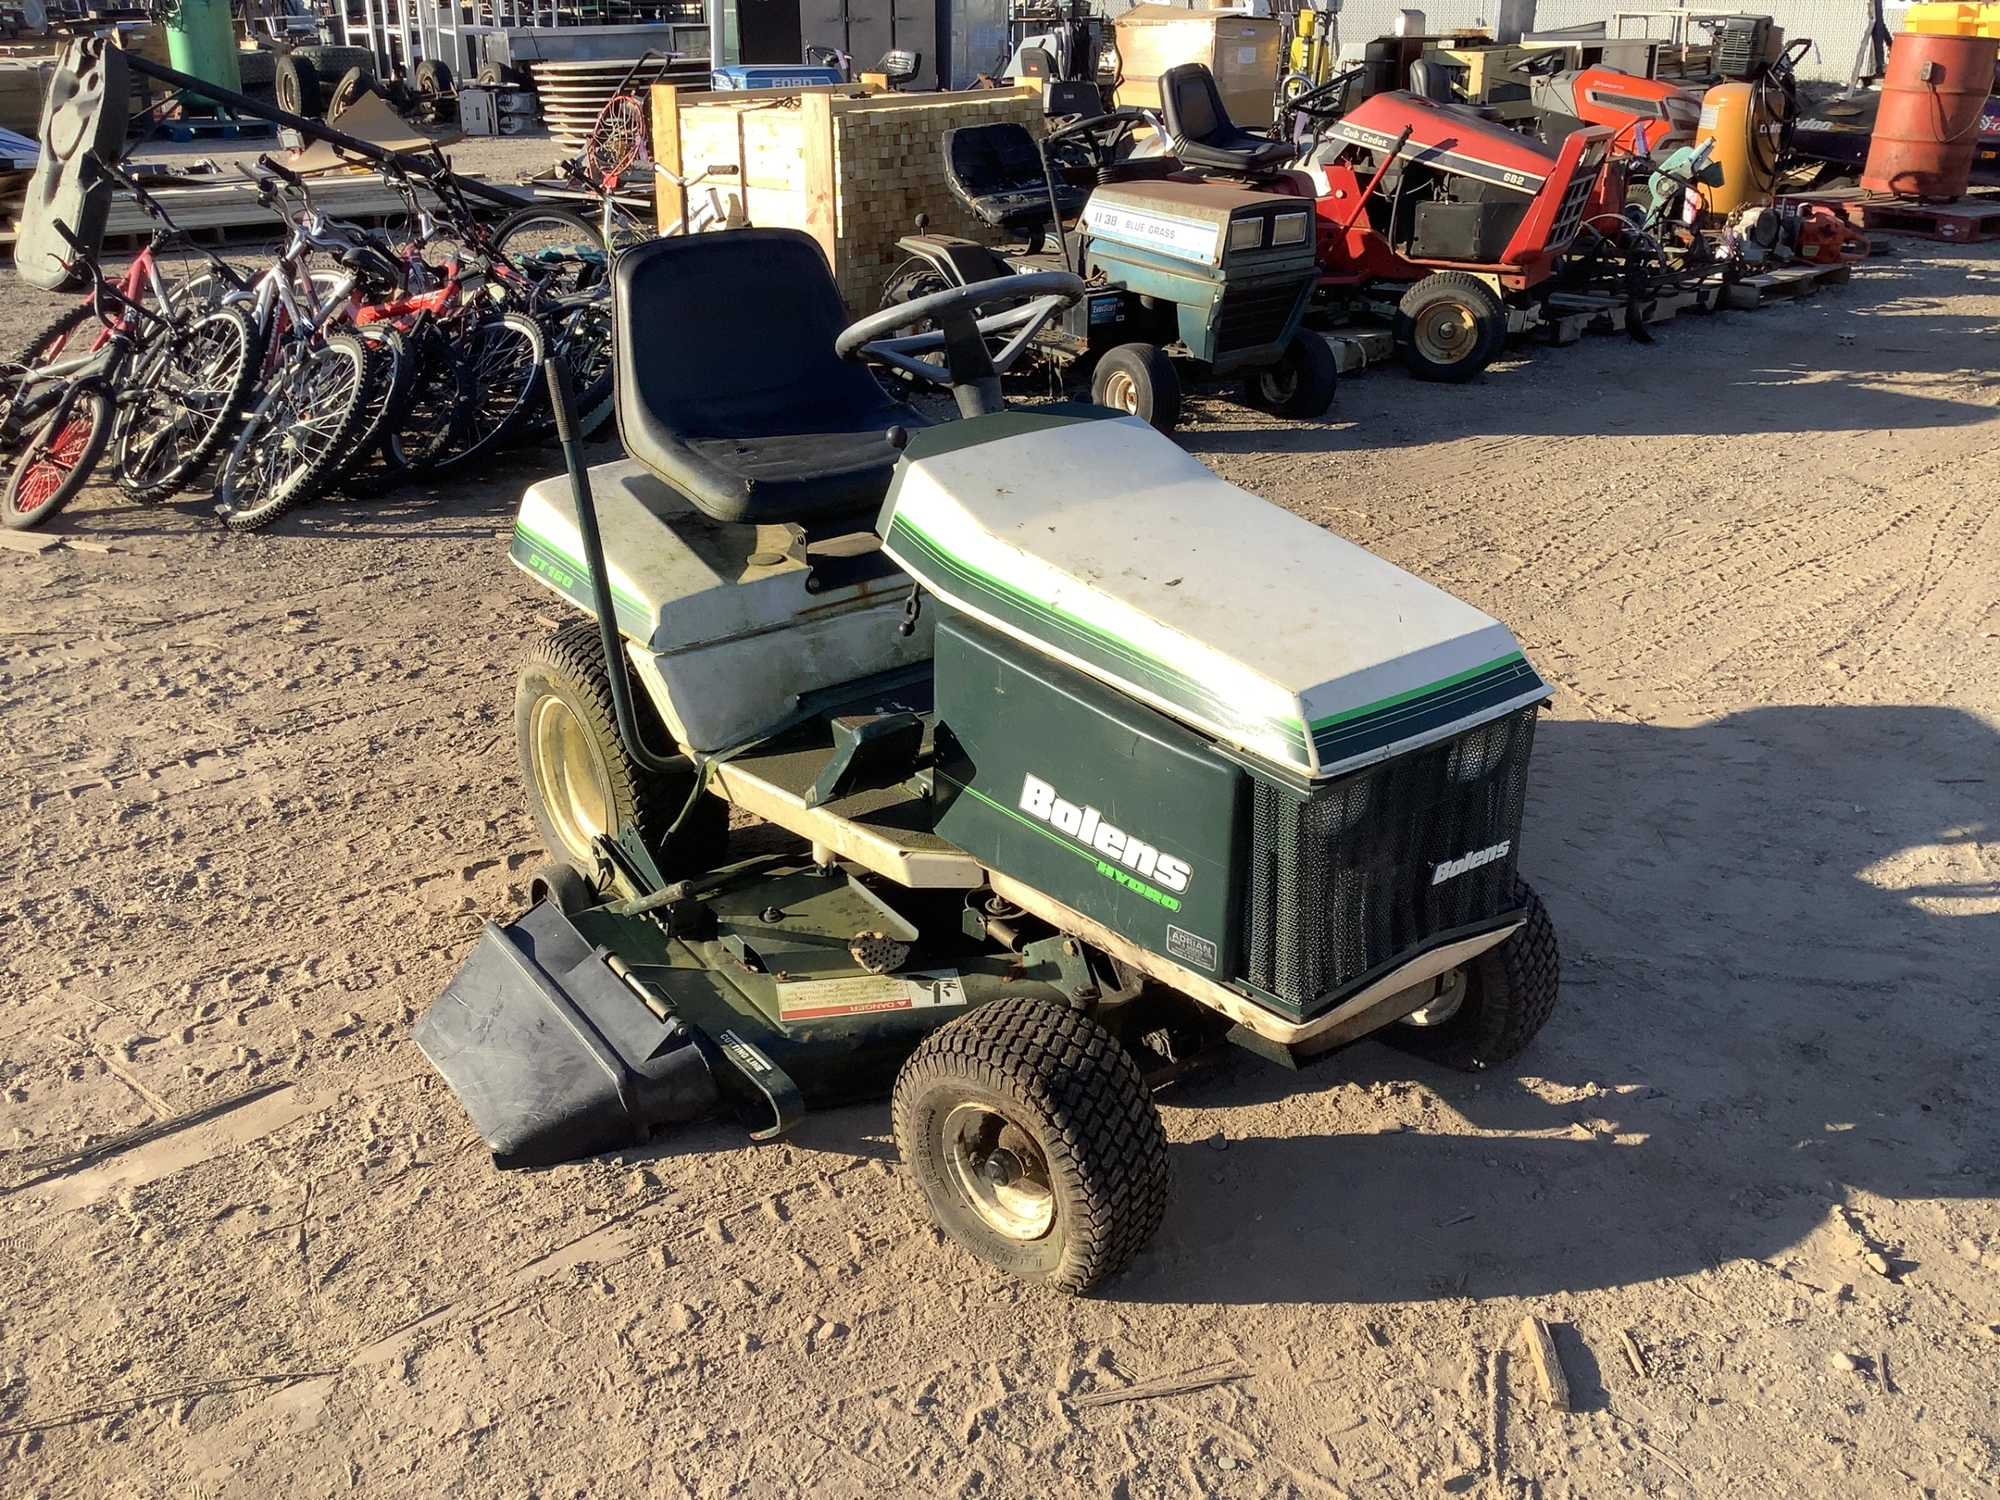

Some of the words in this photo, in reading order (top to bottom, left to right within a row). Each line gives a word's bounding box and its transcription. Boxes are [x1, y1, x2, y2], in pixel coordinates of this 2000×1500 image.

[1343, 127, 1359, 139] Cub
[1361, 133, 1388, 147] Cadet
[1503, 172, 1525, 186] 682
[1125, 220, 1146, 232] BLUE
[1148, 225, 1175, 239] GRASS
[529, 553, 549, 572] ST
[547, 565, 574, 589] 160
[1019, 773, 1192, 893] Bolens
[1432, 839, 1511, 886] Bolens
[1096, 860, 1180, 912] HYDRO
[1172, 931, 1212, 955] ADRIAN
[849, 1001, 895, 1011] DANGER
[720, 1033, 750, 1059] CUTTING
[746, 1056, 765, 1073] LINE
